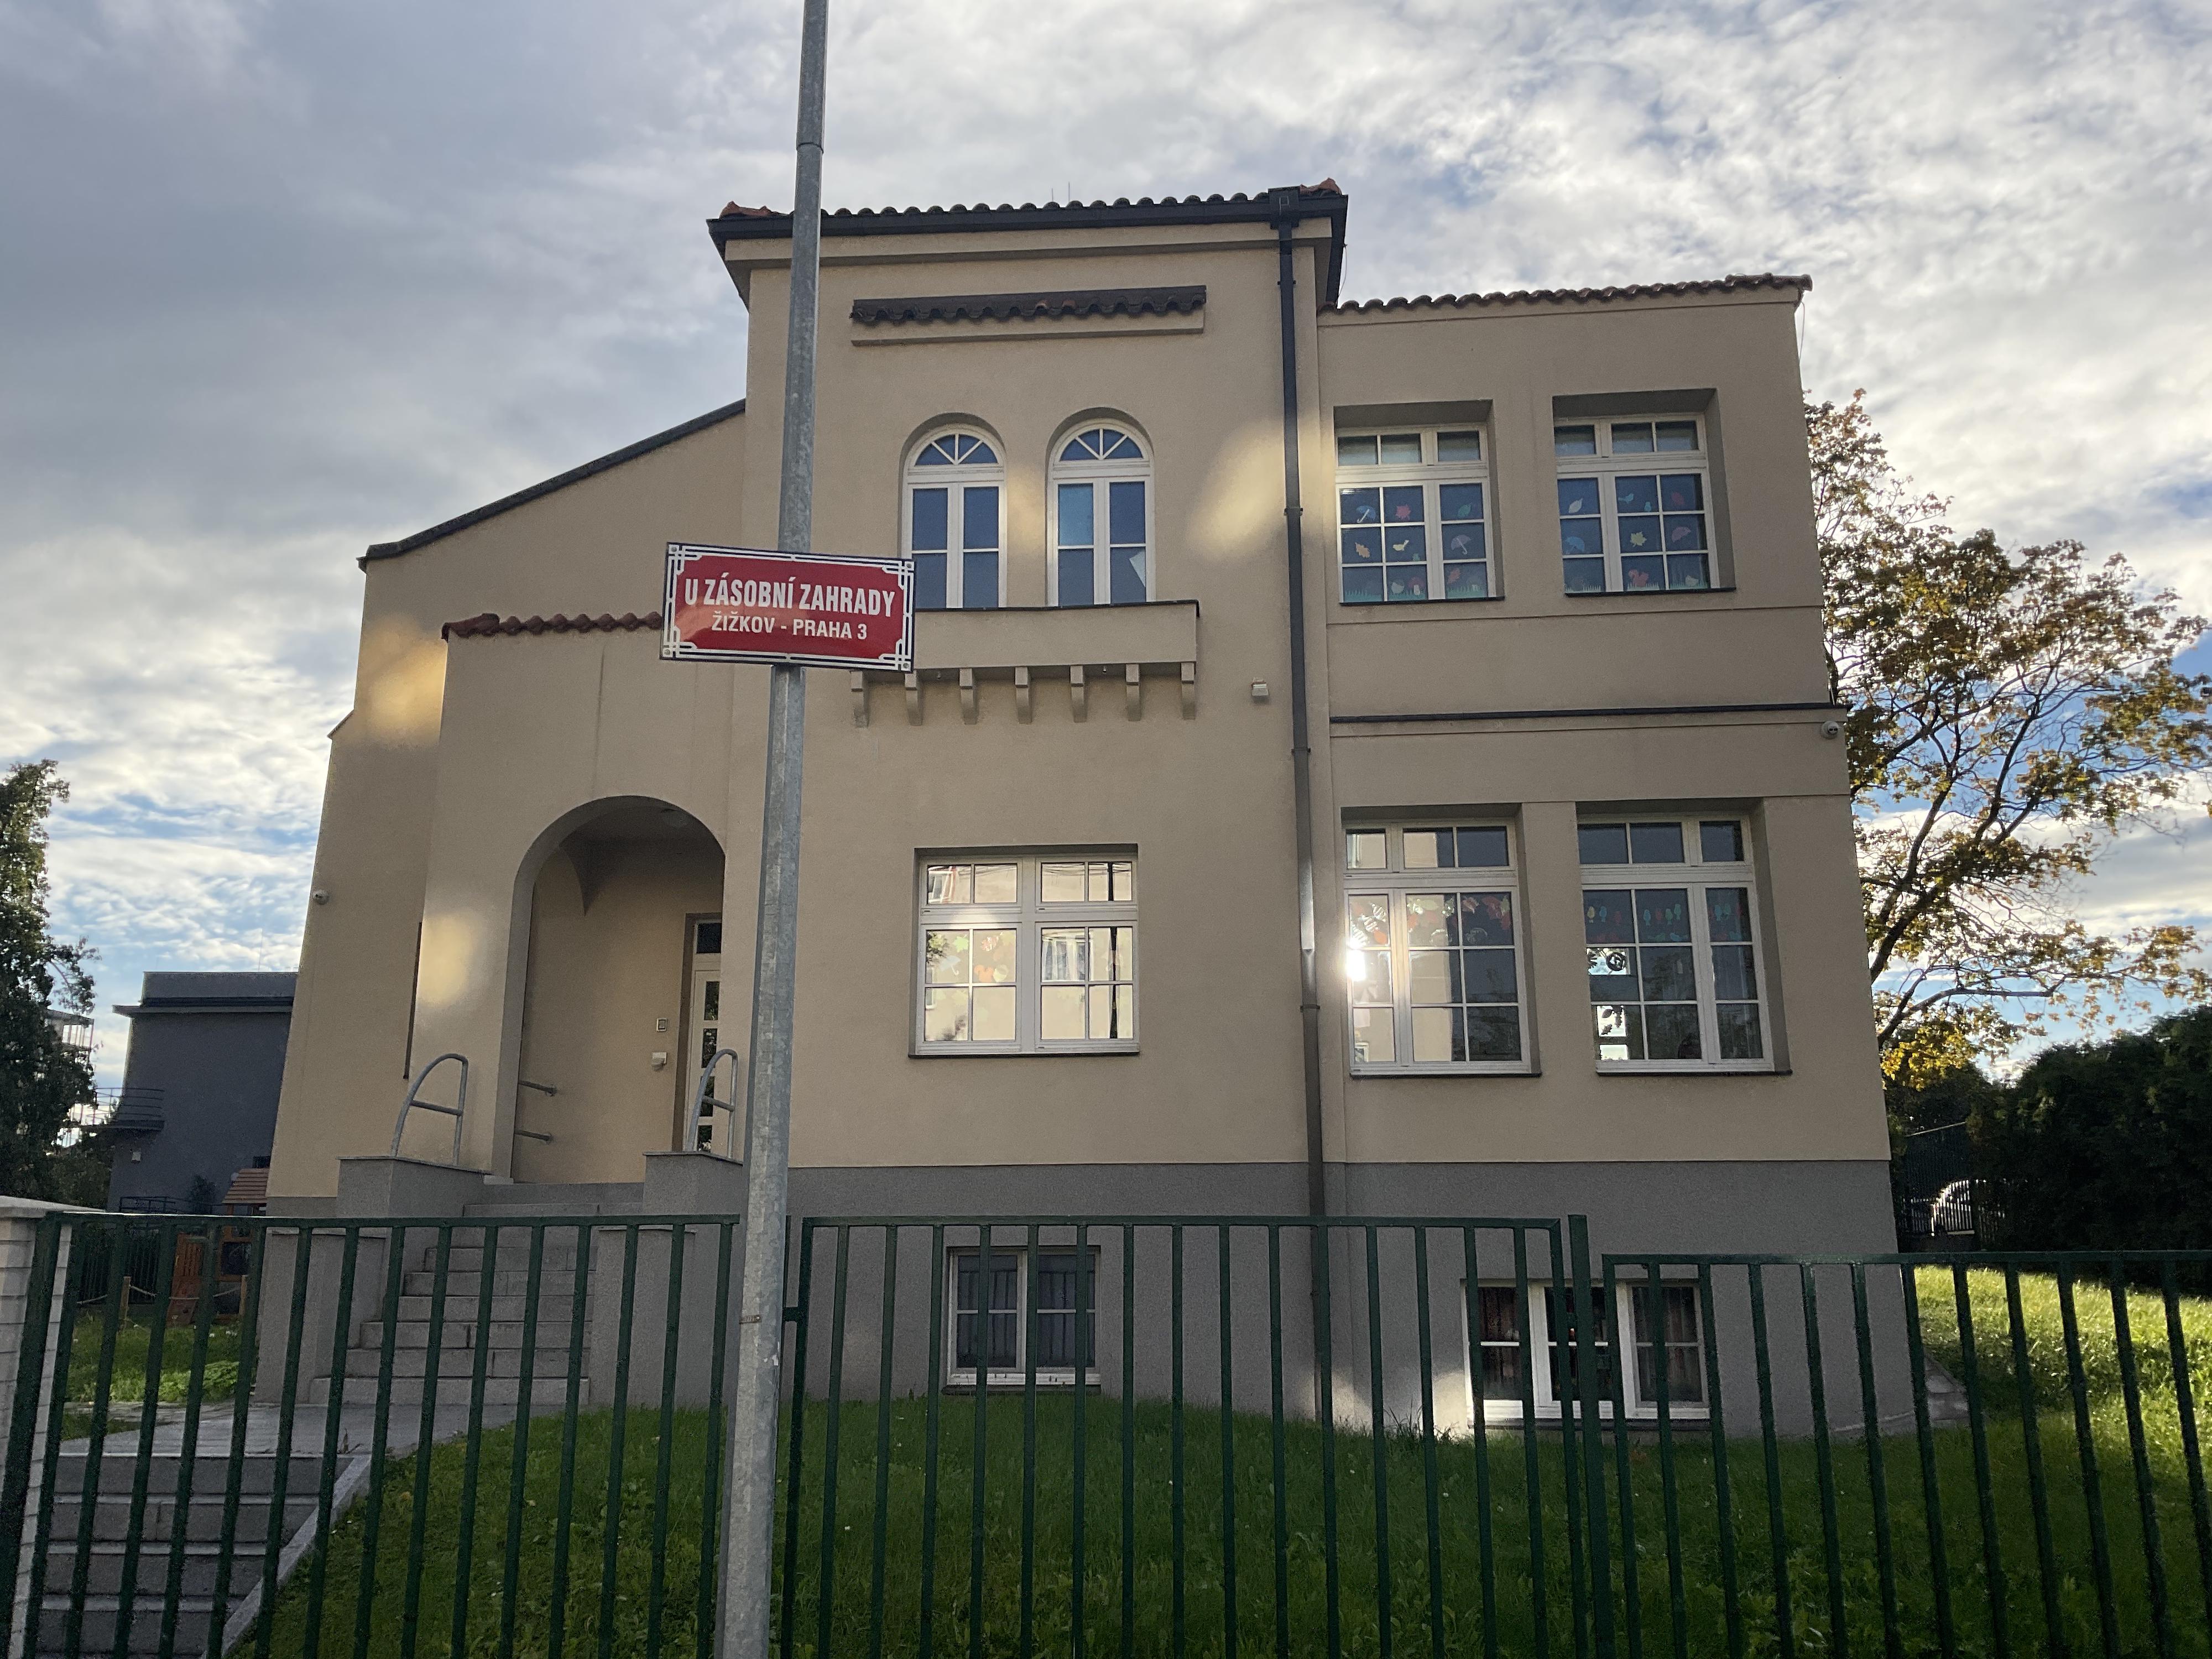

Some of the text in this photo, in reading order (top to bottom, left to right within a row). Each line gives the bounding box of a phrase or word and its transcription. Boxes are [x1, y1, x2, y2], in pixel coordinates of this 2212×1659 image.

[685, 572, 896, 617] U ZÁSOBNÍ ZAHRADY
[712, 611, 775, 634] ŽIŽKOV
[793, 618, 852, 639] PRAHA
[857, 623, 868, 640] 3
